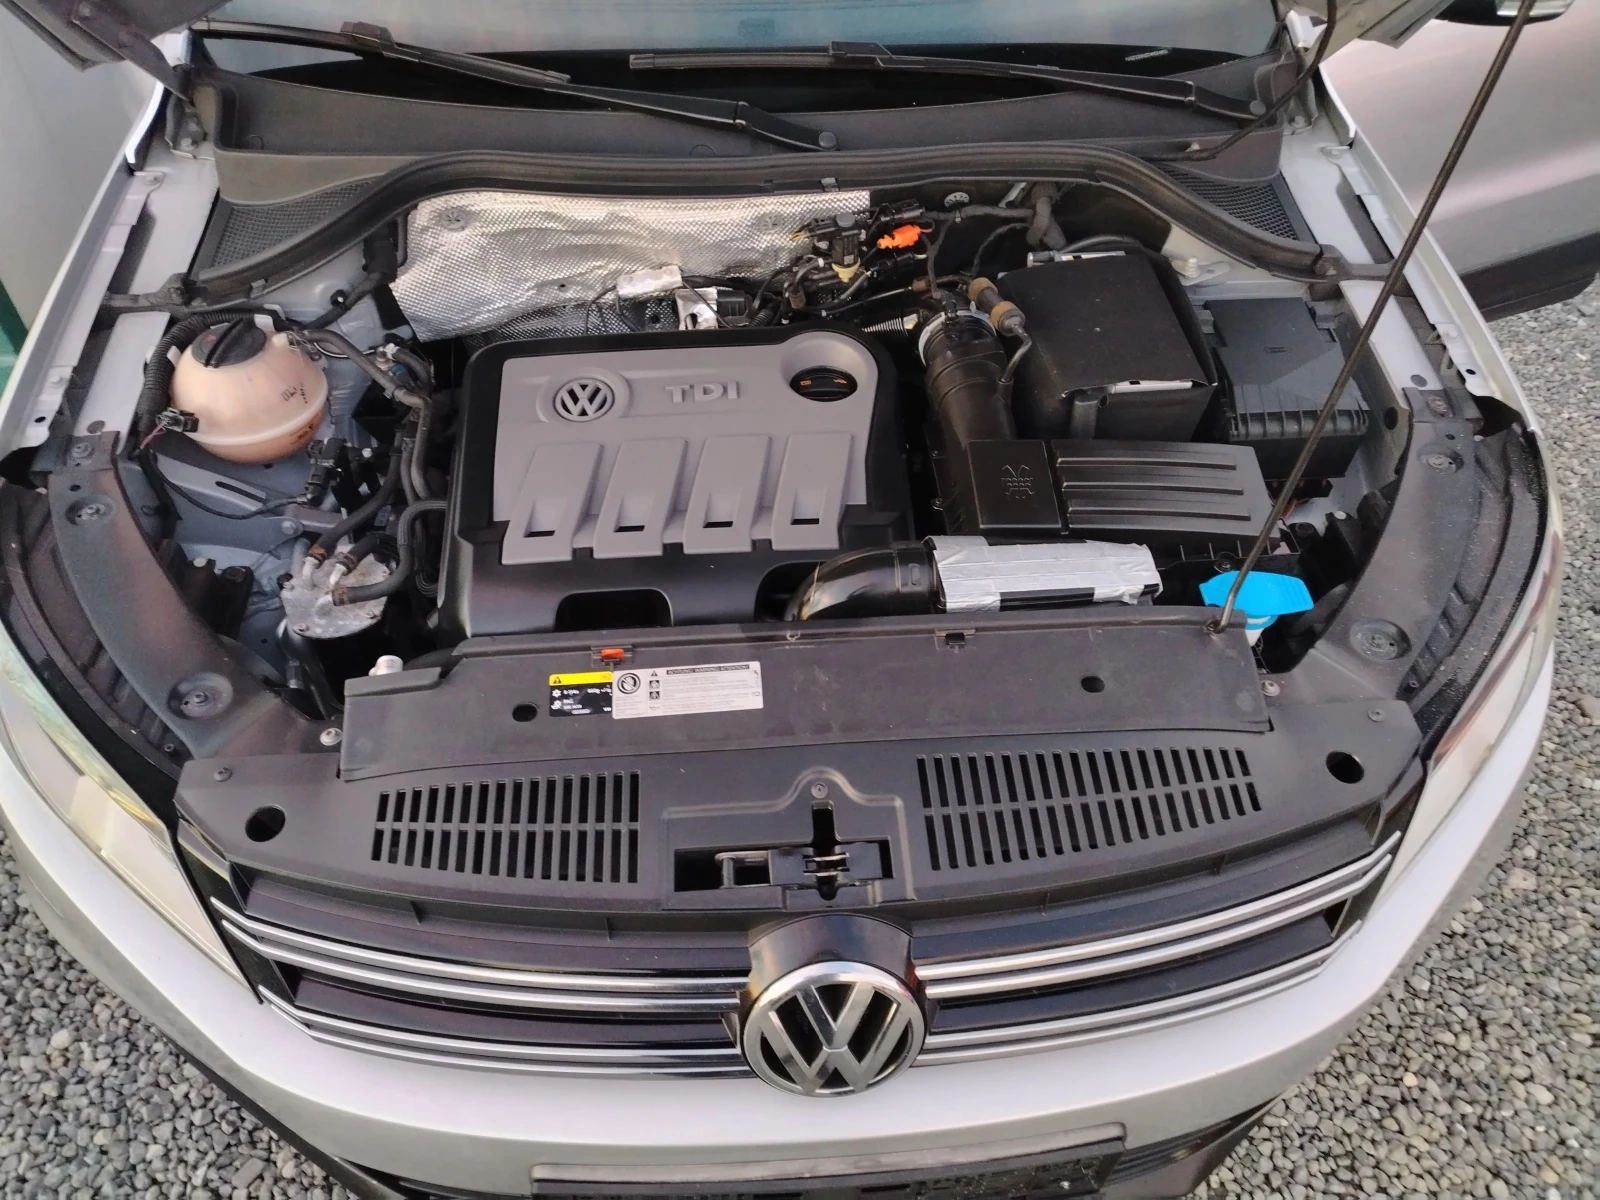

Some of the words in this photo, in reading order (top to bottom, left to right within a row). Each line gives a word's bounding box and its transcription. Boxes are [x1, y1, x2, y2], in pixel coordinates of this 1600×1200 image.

[557, 379, 611, 419] VW
[664, 380, 740, 404] TDI
[754, 976, 916, 1095] VW
